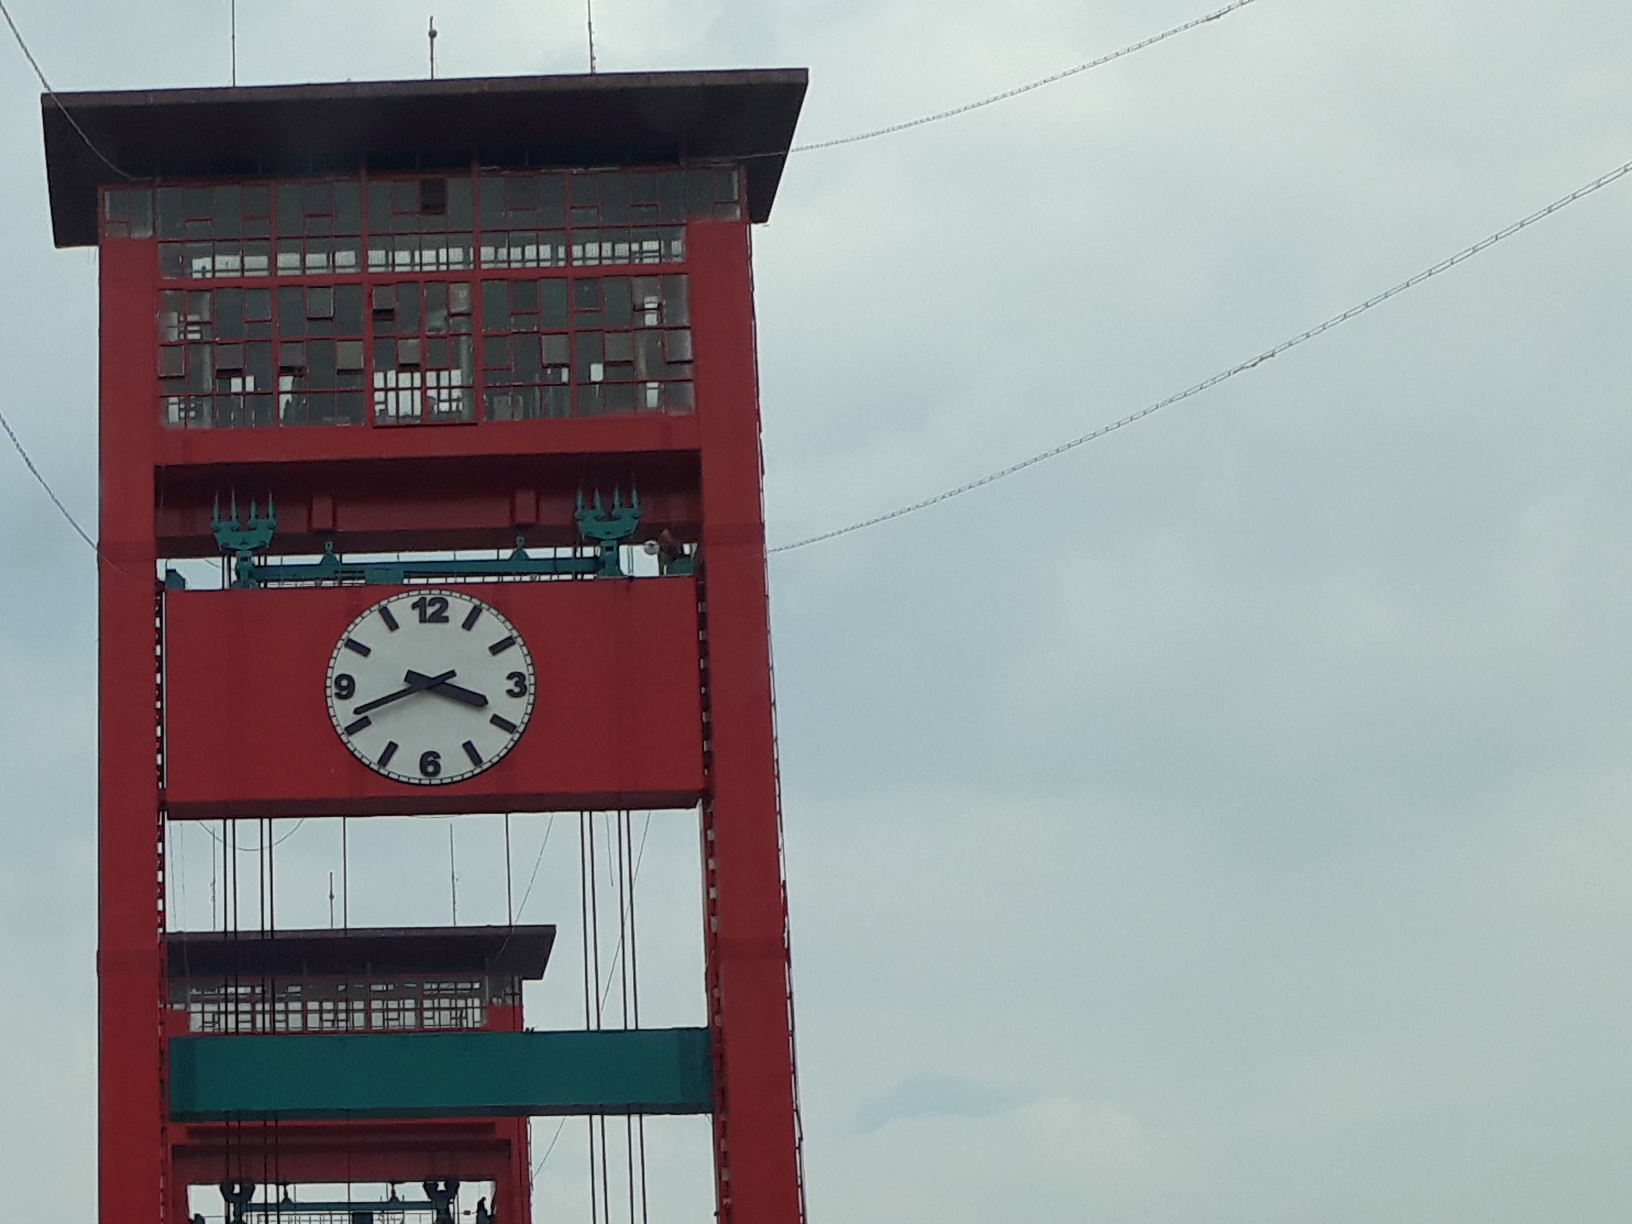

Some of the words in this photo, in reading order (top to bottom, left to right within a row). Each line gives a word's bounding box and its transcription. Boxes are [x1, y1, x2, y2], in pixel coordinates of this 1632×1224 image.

[411, 597, 449, 623] 12
[334, 673, 356, 700] 9
[505, 671, 528, 698] 3
[419, 750, 441, 777] 6
